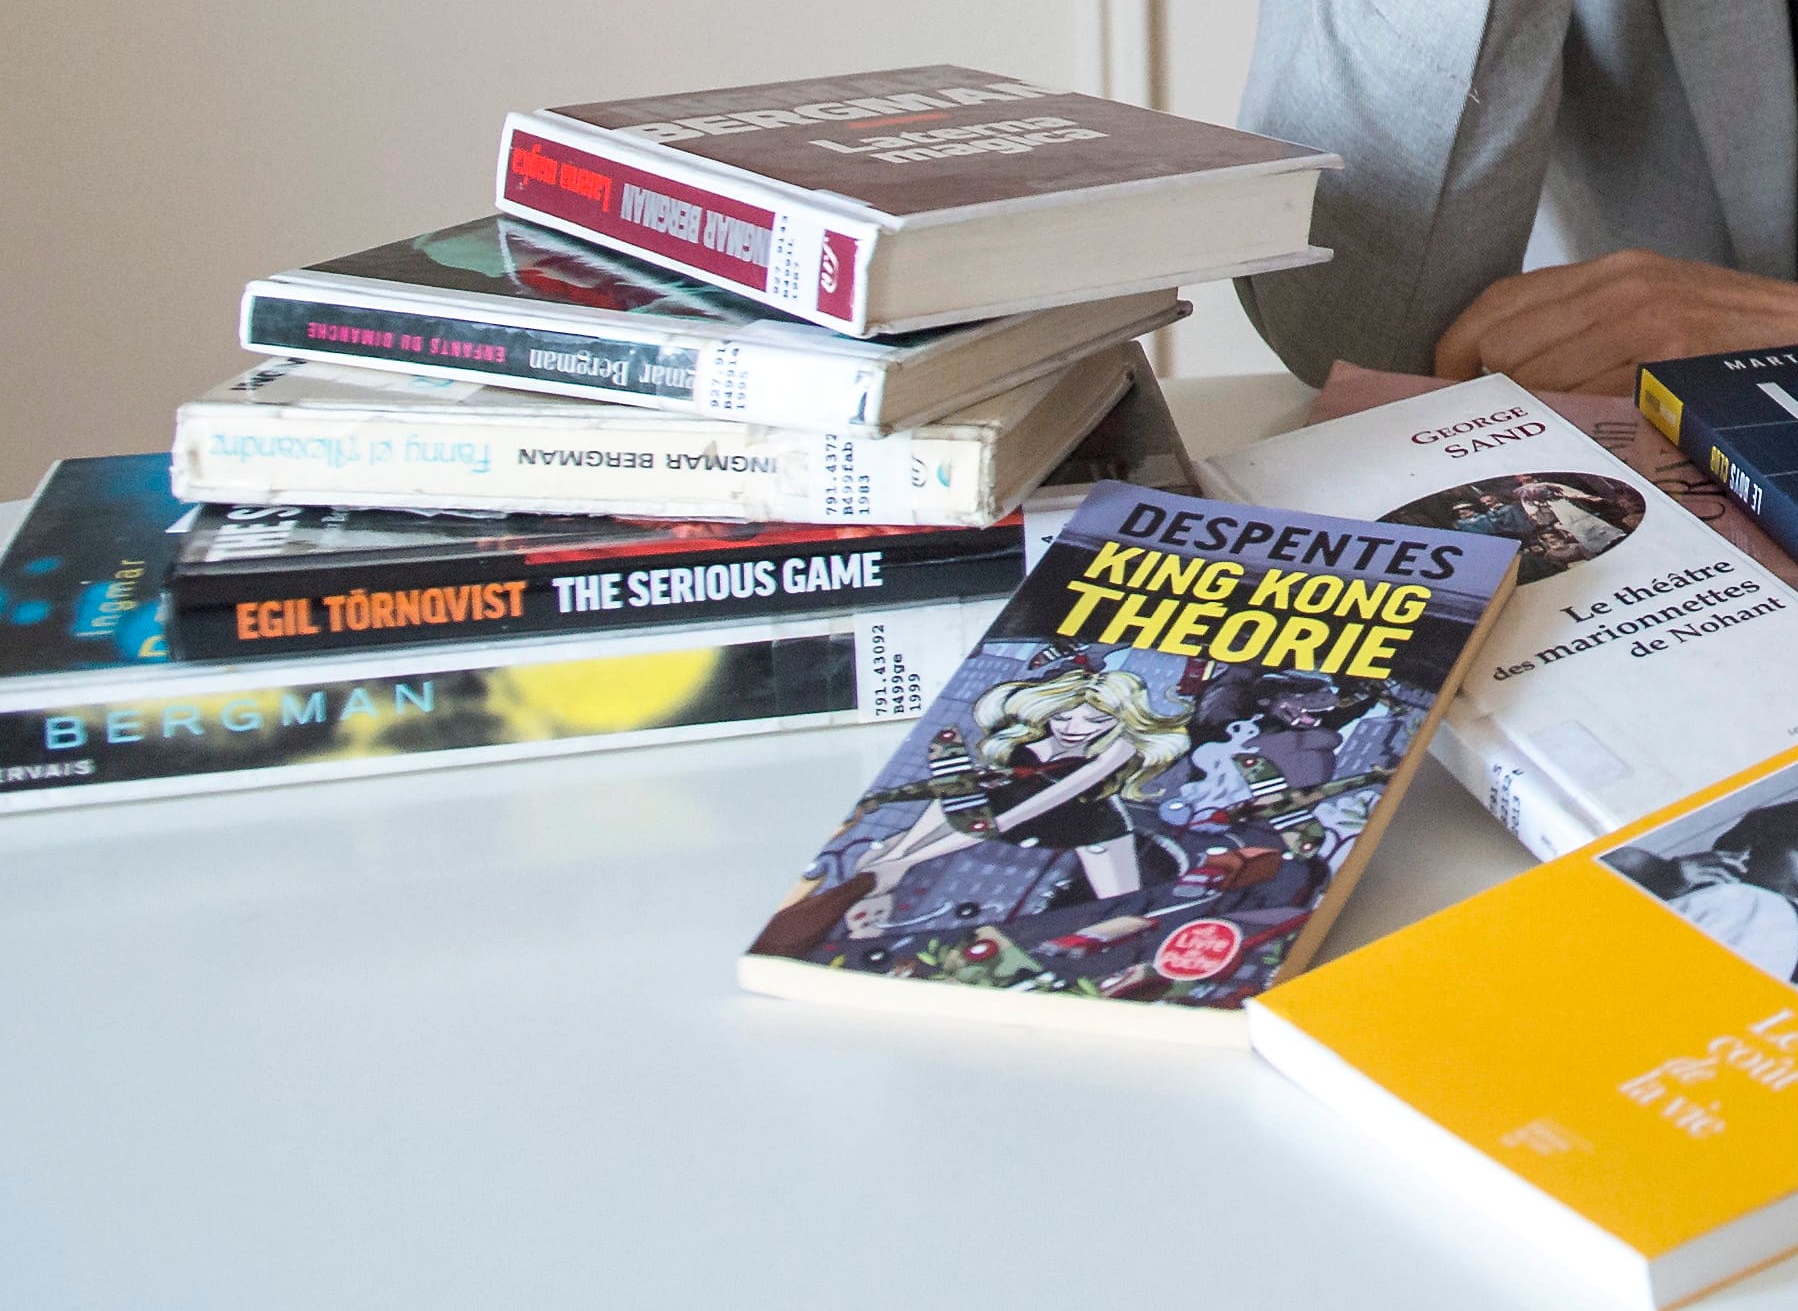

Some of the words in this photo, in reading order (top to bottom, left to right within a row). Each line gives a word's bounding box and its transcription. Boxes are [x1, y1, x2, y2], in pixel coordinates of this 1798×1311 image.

[613, 82, 1075, 144] BERGMAN
[809, 116, 1079, 154] Laterna
[869, 127, 1108, 164] magica
[620, 183, 702, 244] BERGMAN
[306, 321, 395, 350] DIMANCHE
[399, 334, 425, 354] DU
[430, 338, 506, 364] ENFANTS
[528, 347, 630, 387] Bergman
[1410, 405, 1529, 446] GEORGE
[1442, 421, 1548, 460] SAND
[402, 435, 493, 473] Fanny
[516, 448, 655, 471] BERGMAN
[666, 453, 778, 474] INGMAR
[825, 433, 838, 516] 791.4372
[858, 474, 871, 516] 1983
[1118, 503, 1464, 583] DESPENTES
[552, 575, 621, 613] THE
[627, 563, 776, 610] SERIOUS
[782, 551, 884, 597] GAME
[1083, 541, 1244, 601] KING
[1249, 570, 1432, 625] KONG
[1560, 594, 1613, 624] Le
[1613, 558, 1736, 607] théâtre
[235, 600, 321, 641] EGIL
[323, 580, 526, 633] TÖRNQVIST
[1056, 579, 1415, 680] THÉORIE
[1492, 658, 1537, 683] des
[1534, 576, 1762, 667] marionnettes
[1629, 635, 1670, 659] de
[1670, 594, 1787, 644] Nohant
[871, 623, 888, 716] 791.43092
[907, 671, 923, 714] 1999
[44, 681, 436, 751] BERGMAN
